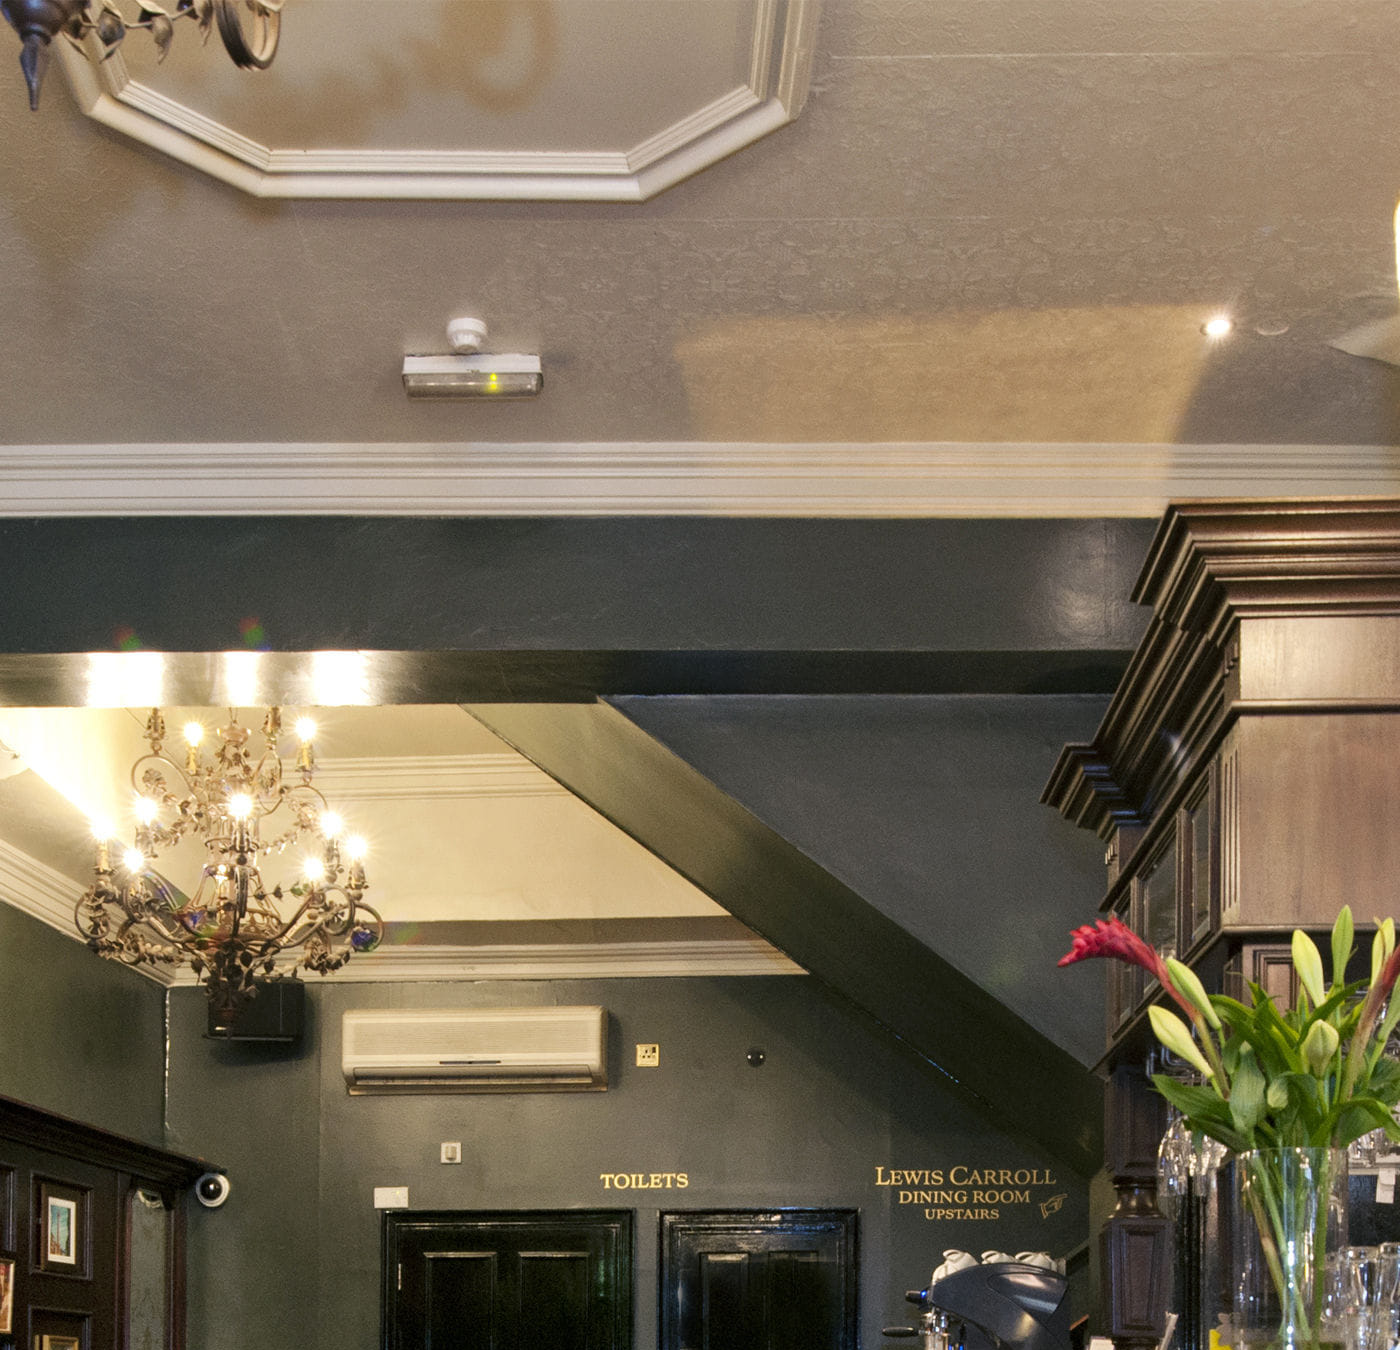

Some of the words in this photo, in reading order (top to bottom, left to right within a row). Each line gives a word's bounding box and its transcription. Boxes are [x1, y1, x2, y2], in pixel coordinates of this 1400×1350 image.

[599, 1173, 689, 1190] TOILETS
[899, 1190, 969, 1205] DINING
[972, 1189, 1031, 1204] ROOM
[924, 1207, 1000, 1221] UPSTAIRS
